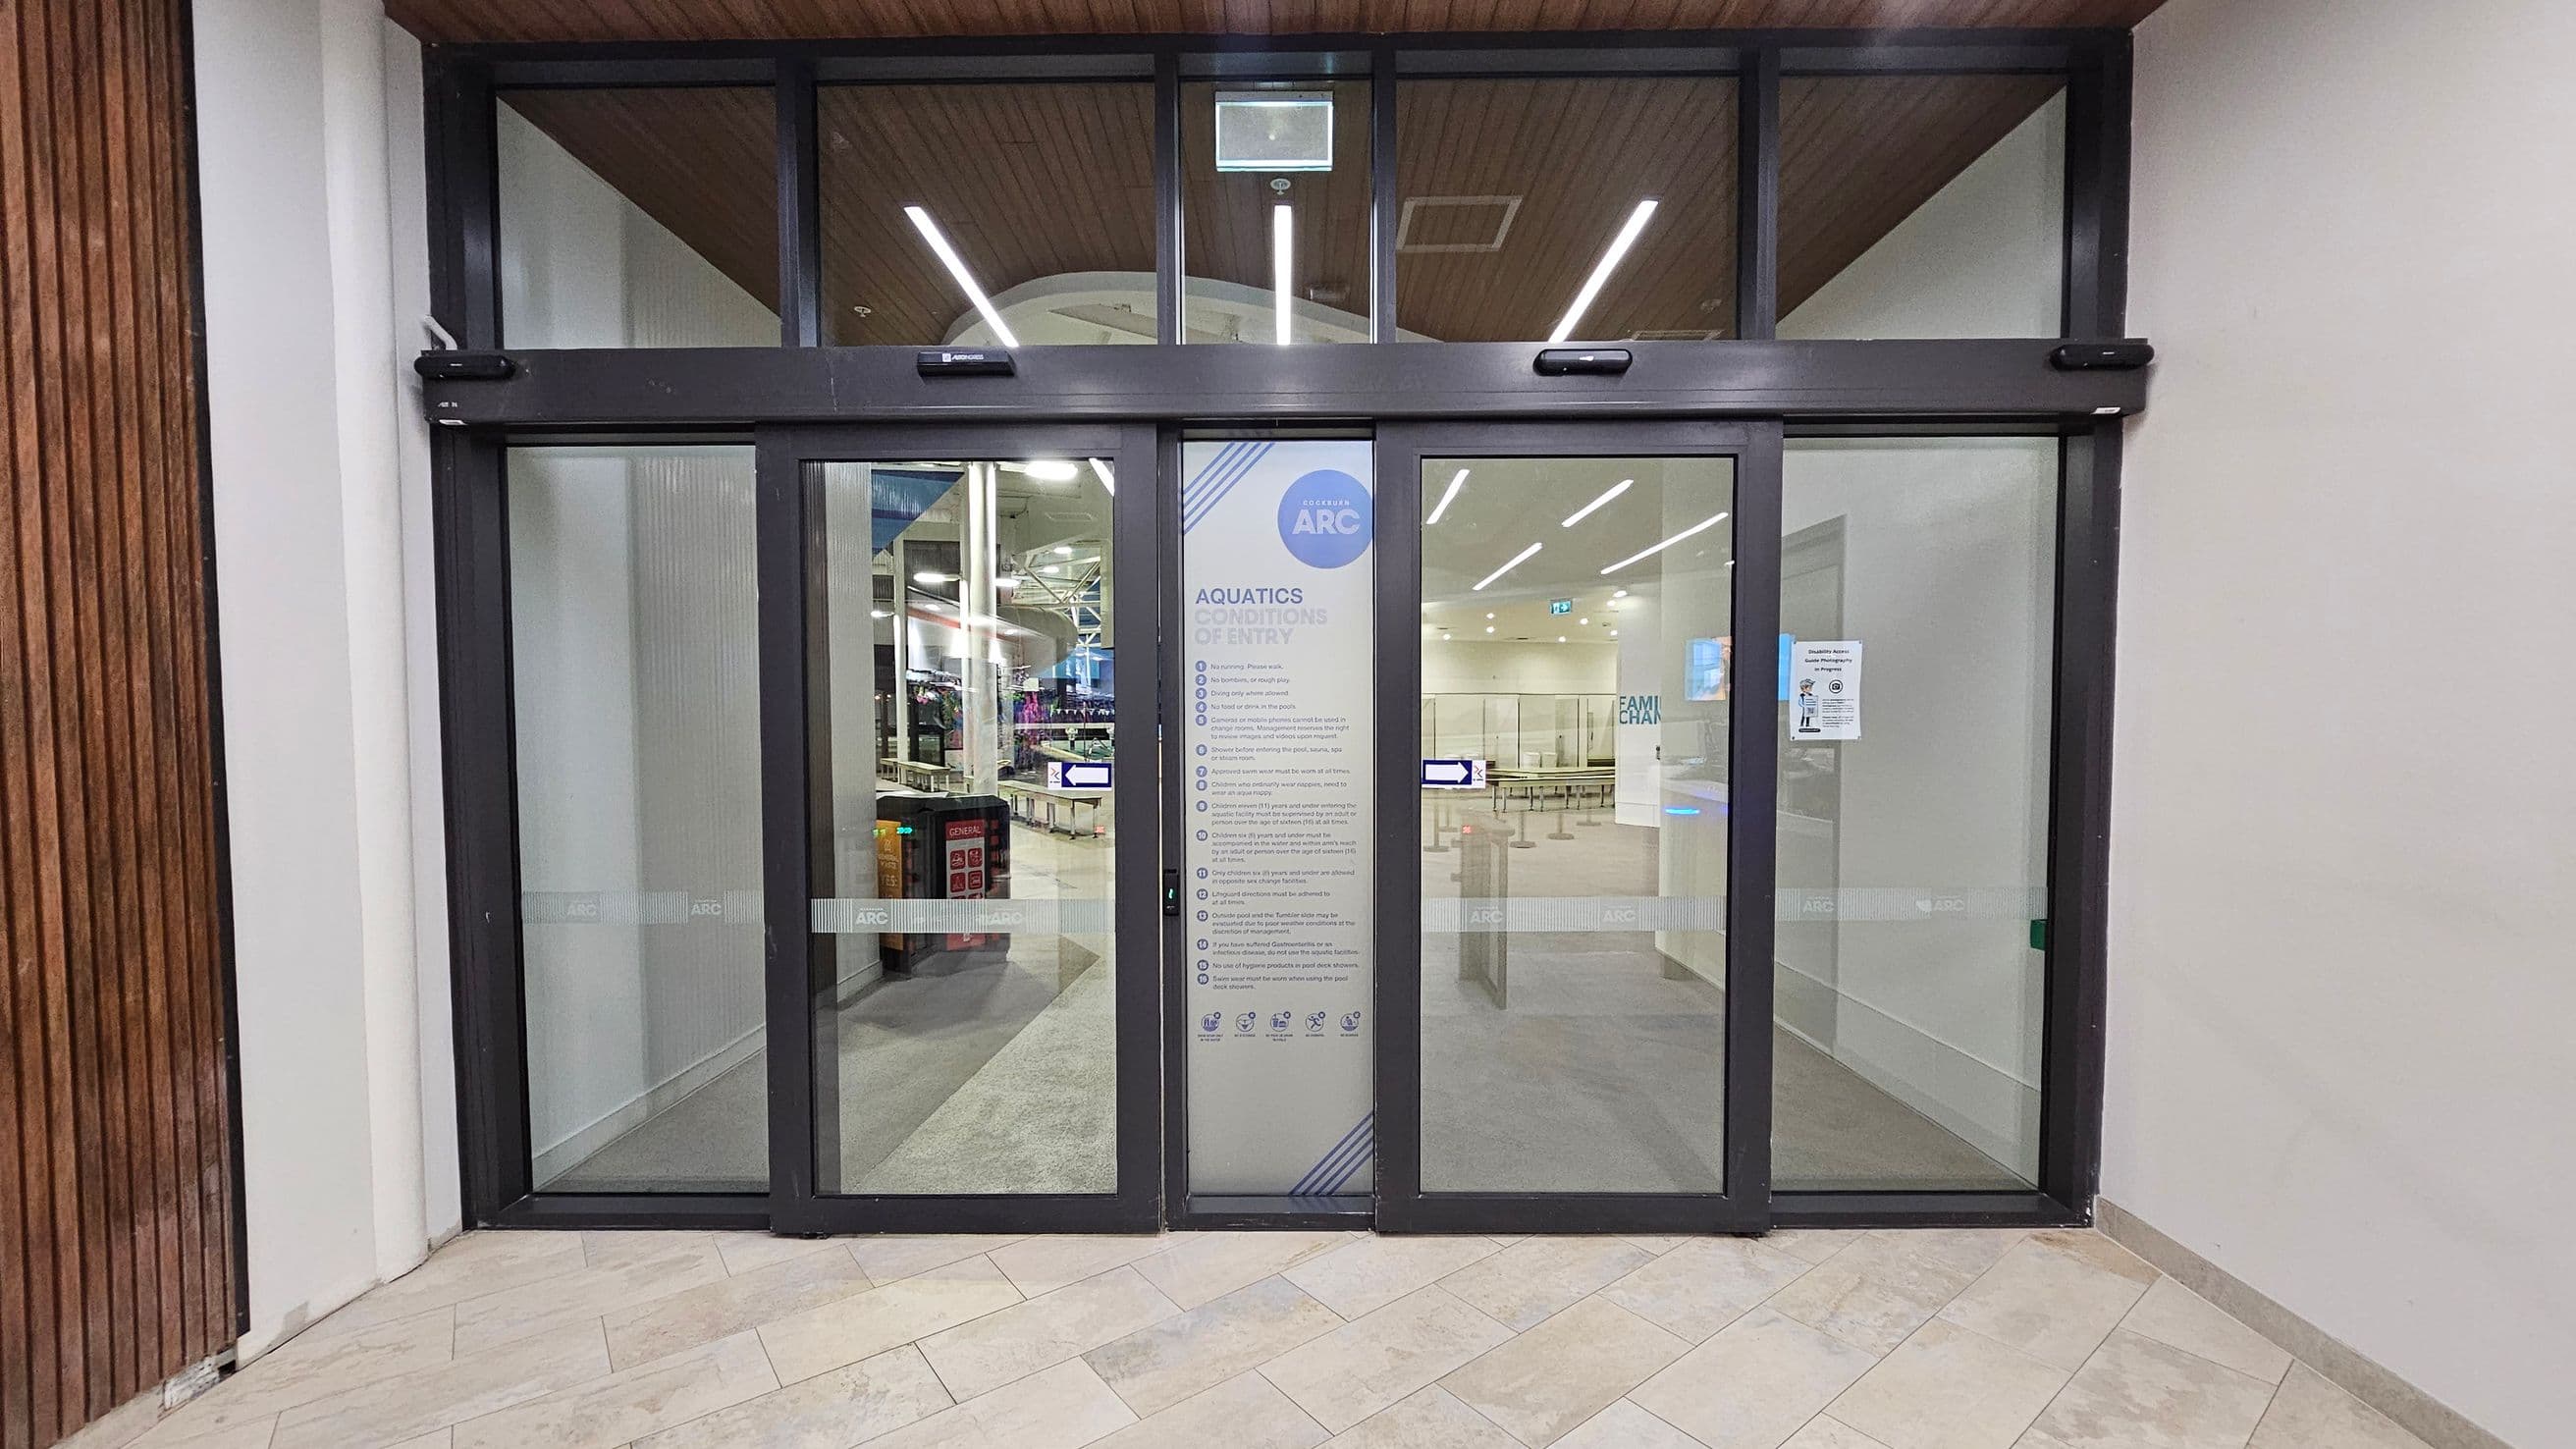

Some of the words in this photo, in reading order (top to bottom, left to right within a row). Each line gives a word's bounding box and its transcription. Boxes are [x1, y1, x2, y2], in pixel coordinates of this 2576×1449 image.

[1292, 509, 1360, 535] ARC
[1196, 588, 1303, 605] AQUATICS
[1195, 608, 1328, 625] CONDITIONS
[1195, 627, 1221, 645] OF
[1227, 627, 1294, 645] ENTRY
[1620, 695, 1661, 710] FAMI
[949, 826, 982, 836] GENERAL
[691, 903, 722, 915] ARC
[1803, 900, 1834, 913] ARC
[1933, 899, 1964, 912] ARC
[855, 912, 888, 925] ARC
[988, 912, 1023, 925] ARC
[1471, 910, 1503, 923] ARC
[1603, 910, 1637, 923] ARC
